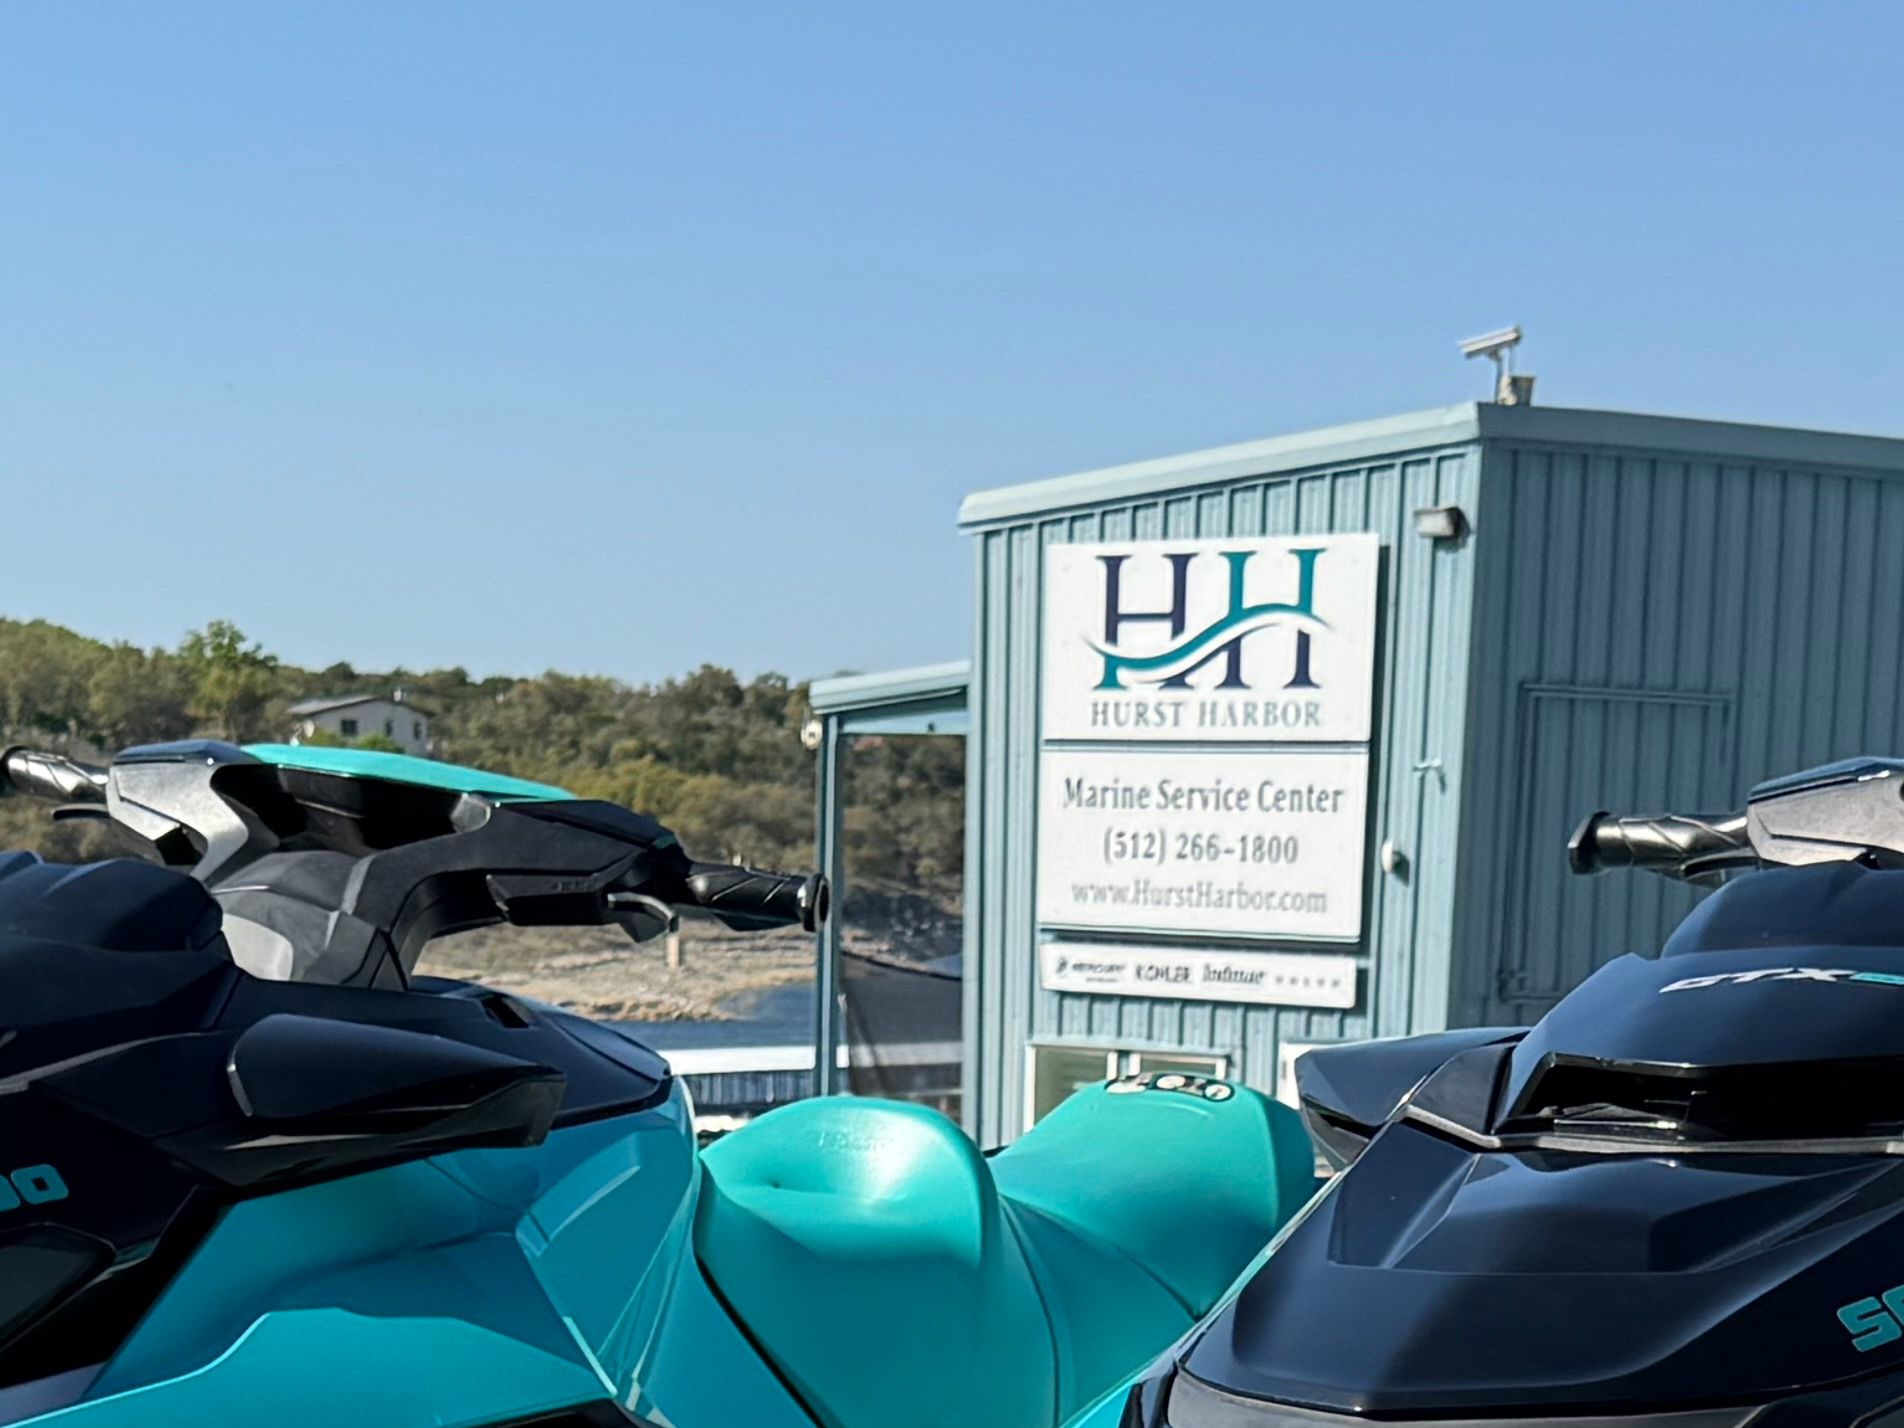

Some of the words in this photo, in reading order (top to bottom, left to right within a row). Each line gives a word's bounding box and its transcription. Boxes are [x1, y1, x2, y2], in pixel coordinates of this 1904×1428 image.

[1091, 701, 1184, 727] HURST
[1198, 701, 1321, 727] HARBOR
[1063, 777, 1151, 809] Marine
[1156, 778, 1250, 812] Service
[1257, 780, 1345, 812] Center
[1103, 826, 1166, 865] (512)
[1175, 832, 1299, 864] 266-1800
[1072, 878, 1327, 913] www.HurstHarbor.com
